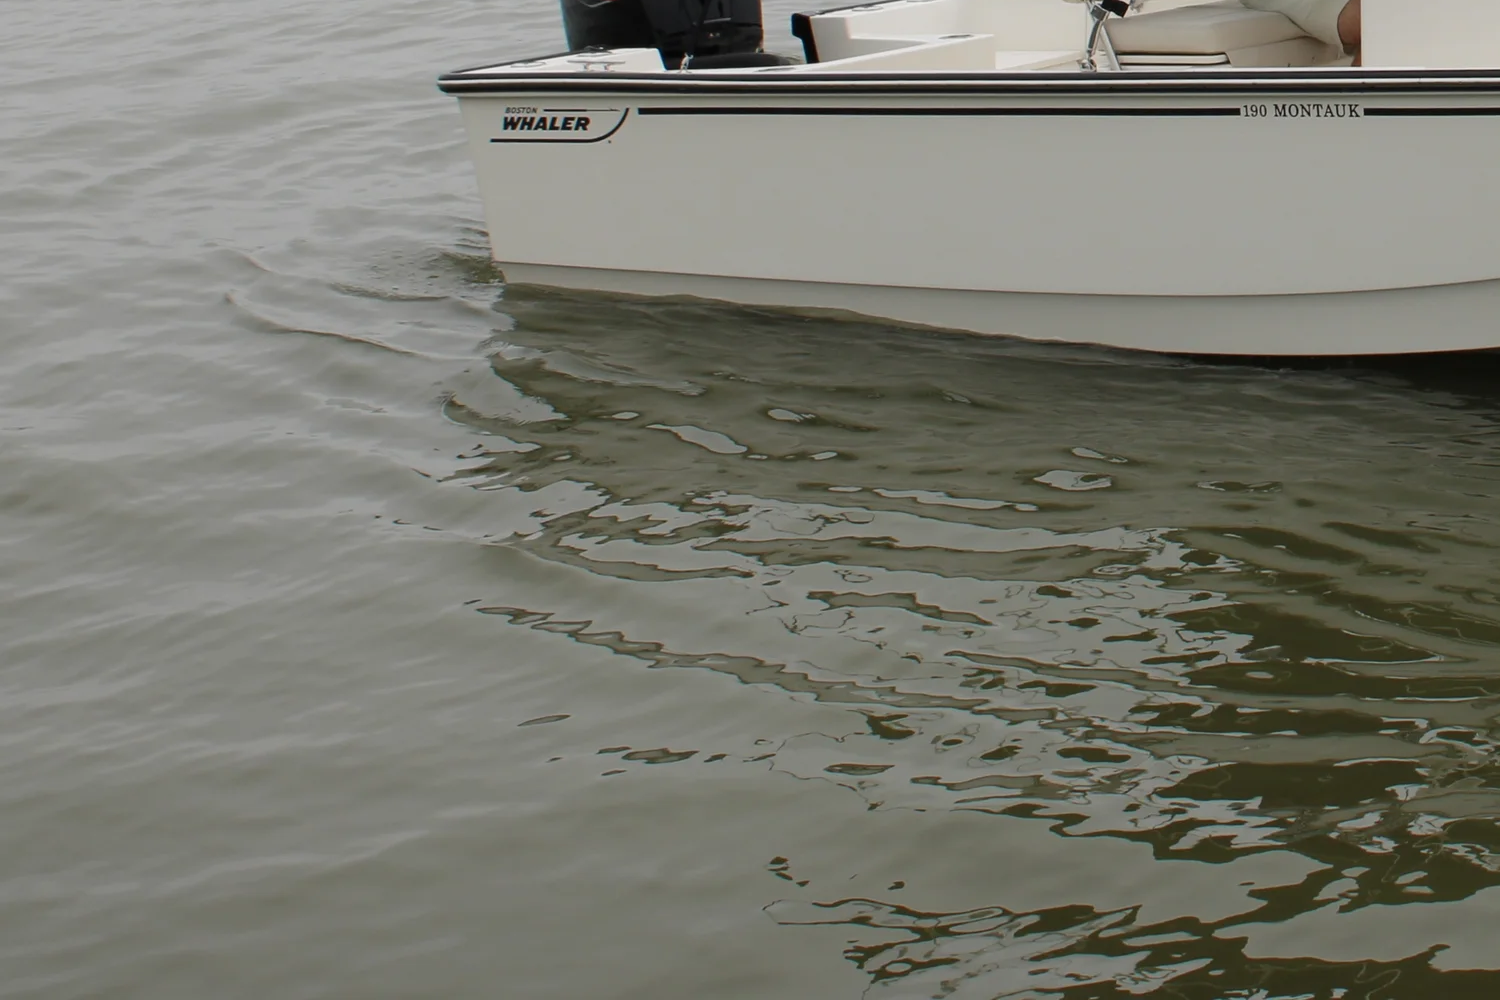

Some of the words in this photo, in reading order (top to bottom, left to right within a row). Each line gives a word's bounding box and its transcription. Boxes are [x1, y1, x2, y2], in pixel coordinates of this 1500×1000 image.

[1243, 104, 1267, 117] 190
[1273, 103, 1360, 118] MONTAUK
[503, 116, 591, 131] WHALER
